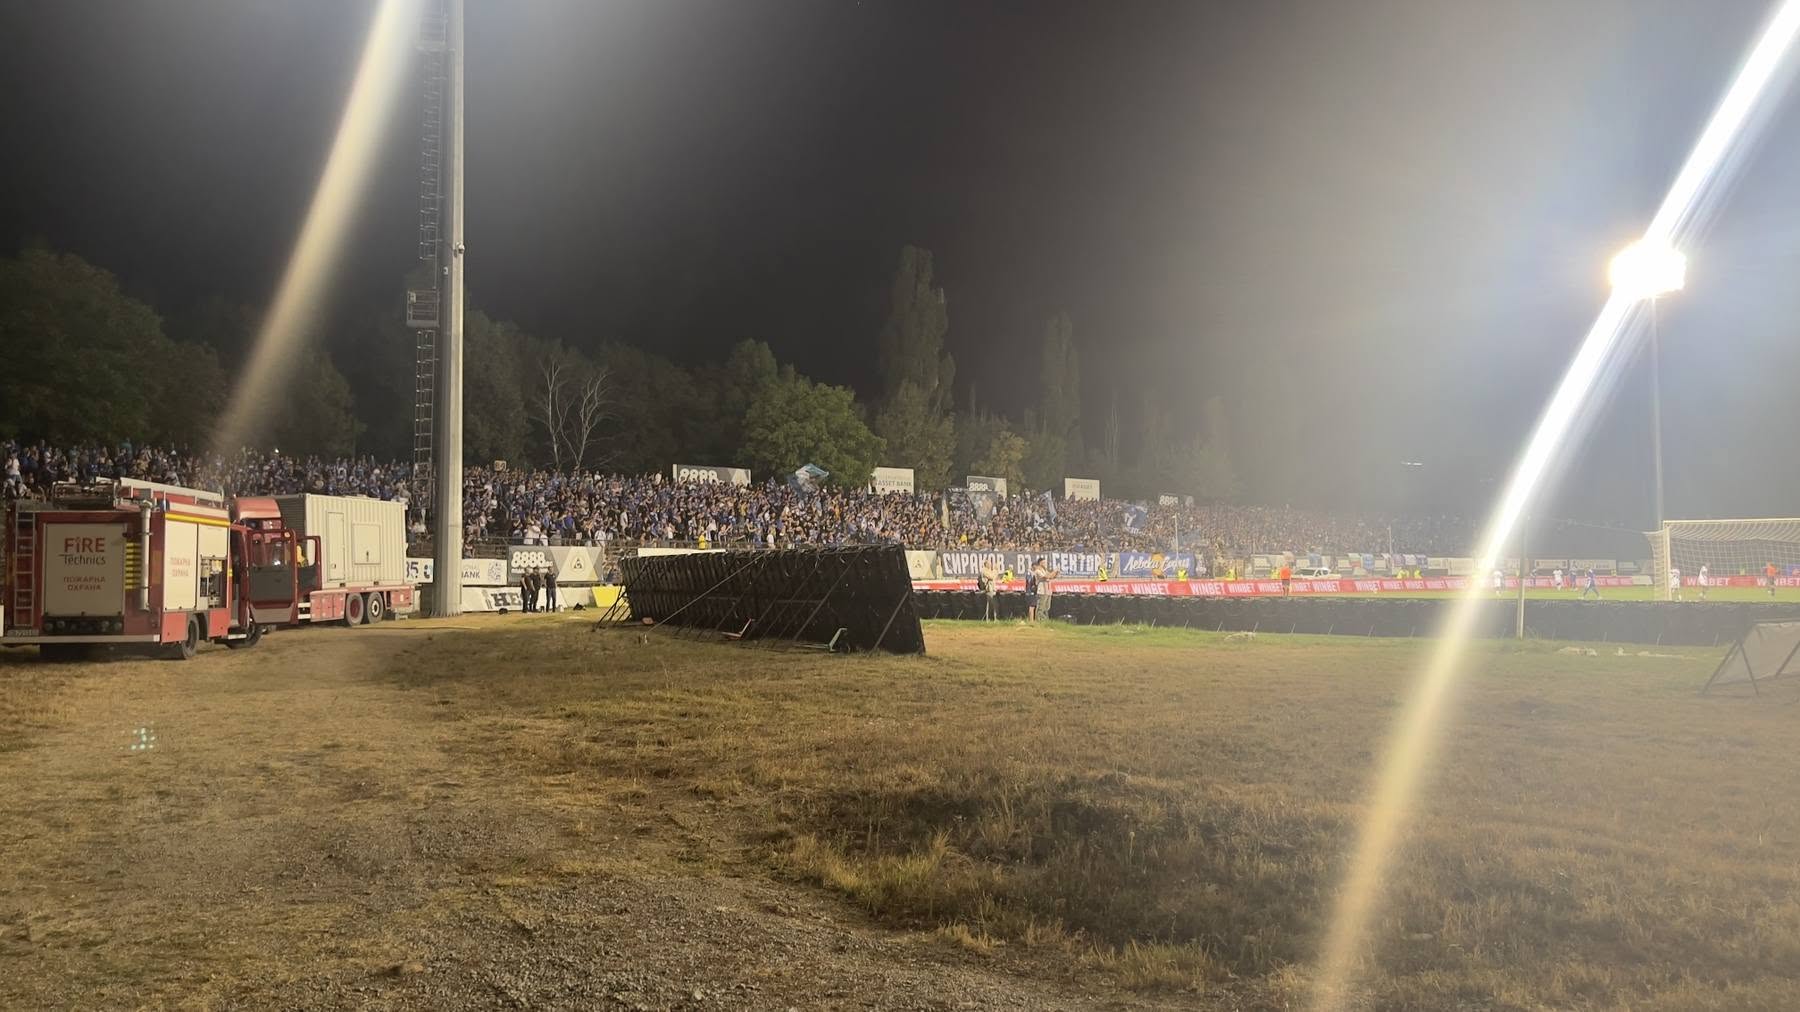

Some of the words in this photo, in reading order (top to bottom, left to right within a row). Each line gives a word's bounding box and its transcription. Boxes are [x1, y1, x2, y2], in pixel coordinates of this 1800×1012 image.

[58, 553, 106, 566] Technics
[942, 553, 1005, 575] СИРАКОВ
[1687, 577, 1729, 586] WBET
[1131, 583, 1169, 595] WINBET
[1189, 582, 1226, 595] WINBET
